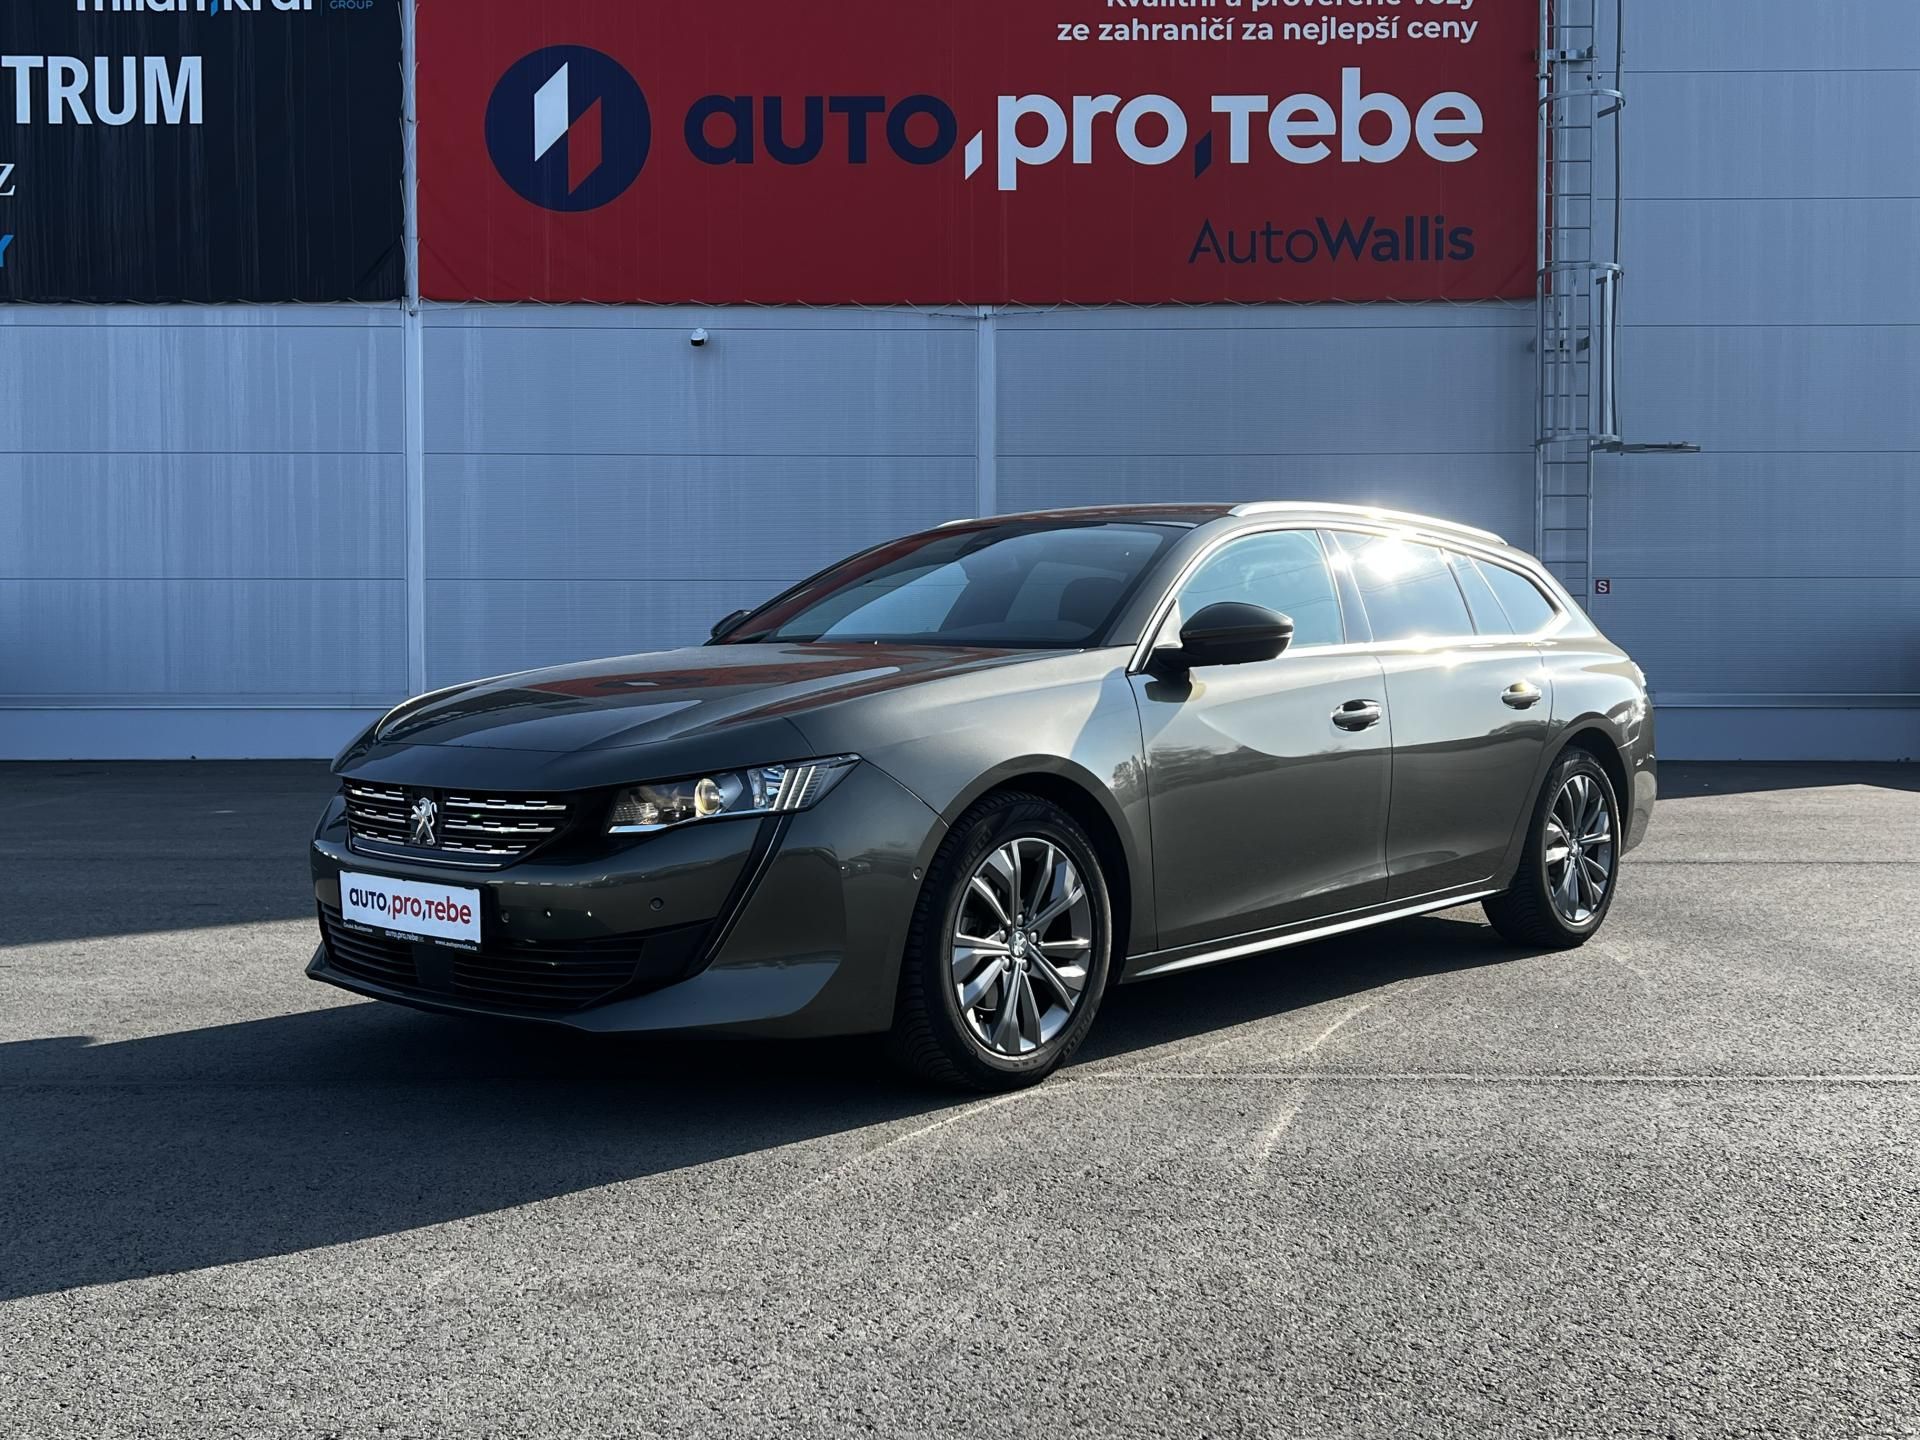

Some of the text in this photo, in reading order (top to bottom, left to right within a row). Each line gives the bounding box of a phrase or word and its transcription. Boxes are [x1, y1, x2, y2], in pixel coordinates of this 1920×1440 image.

[329, 0, 374, 10] GROUP
[1057, 15, 1479, 46] ze zahraničí za nejlepší ceny
[1, 55, 203, 126] TRUM
[1187, 213, 1476, 265] AutoWallis
[1597, 581, 1608, 593] S
